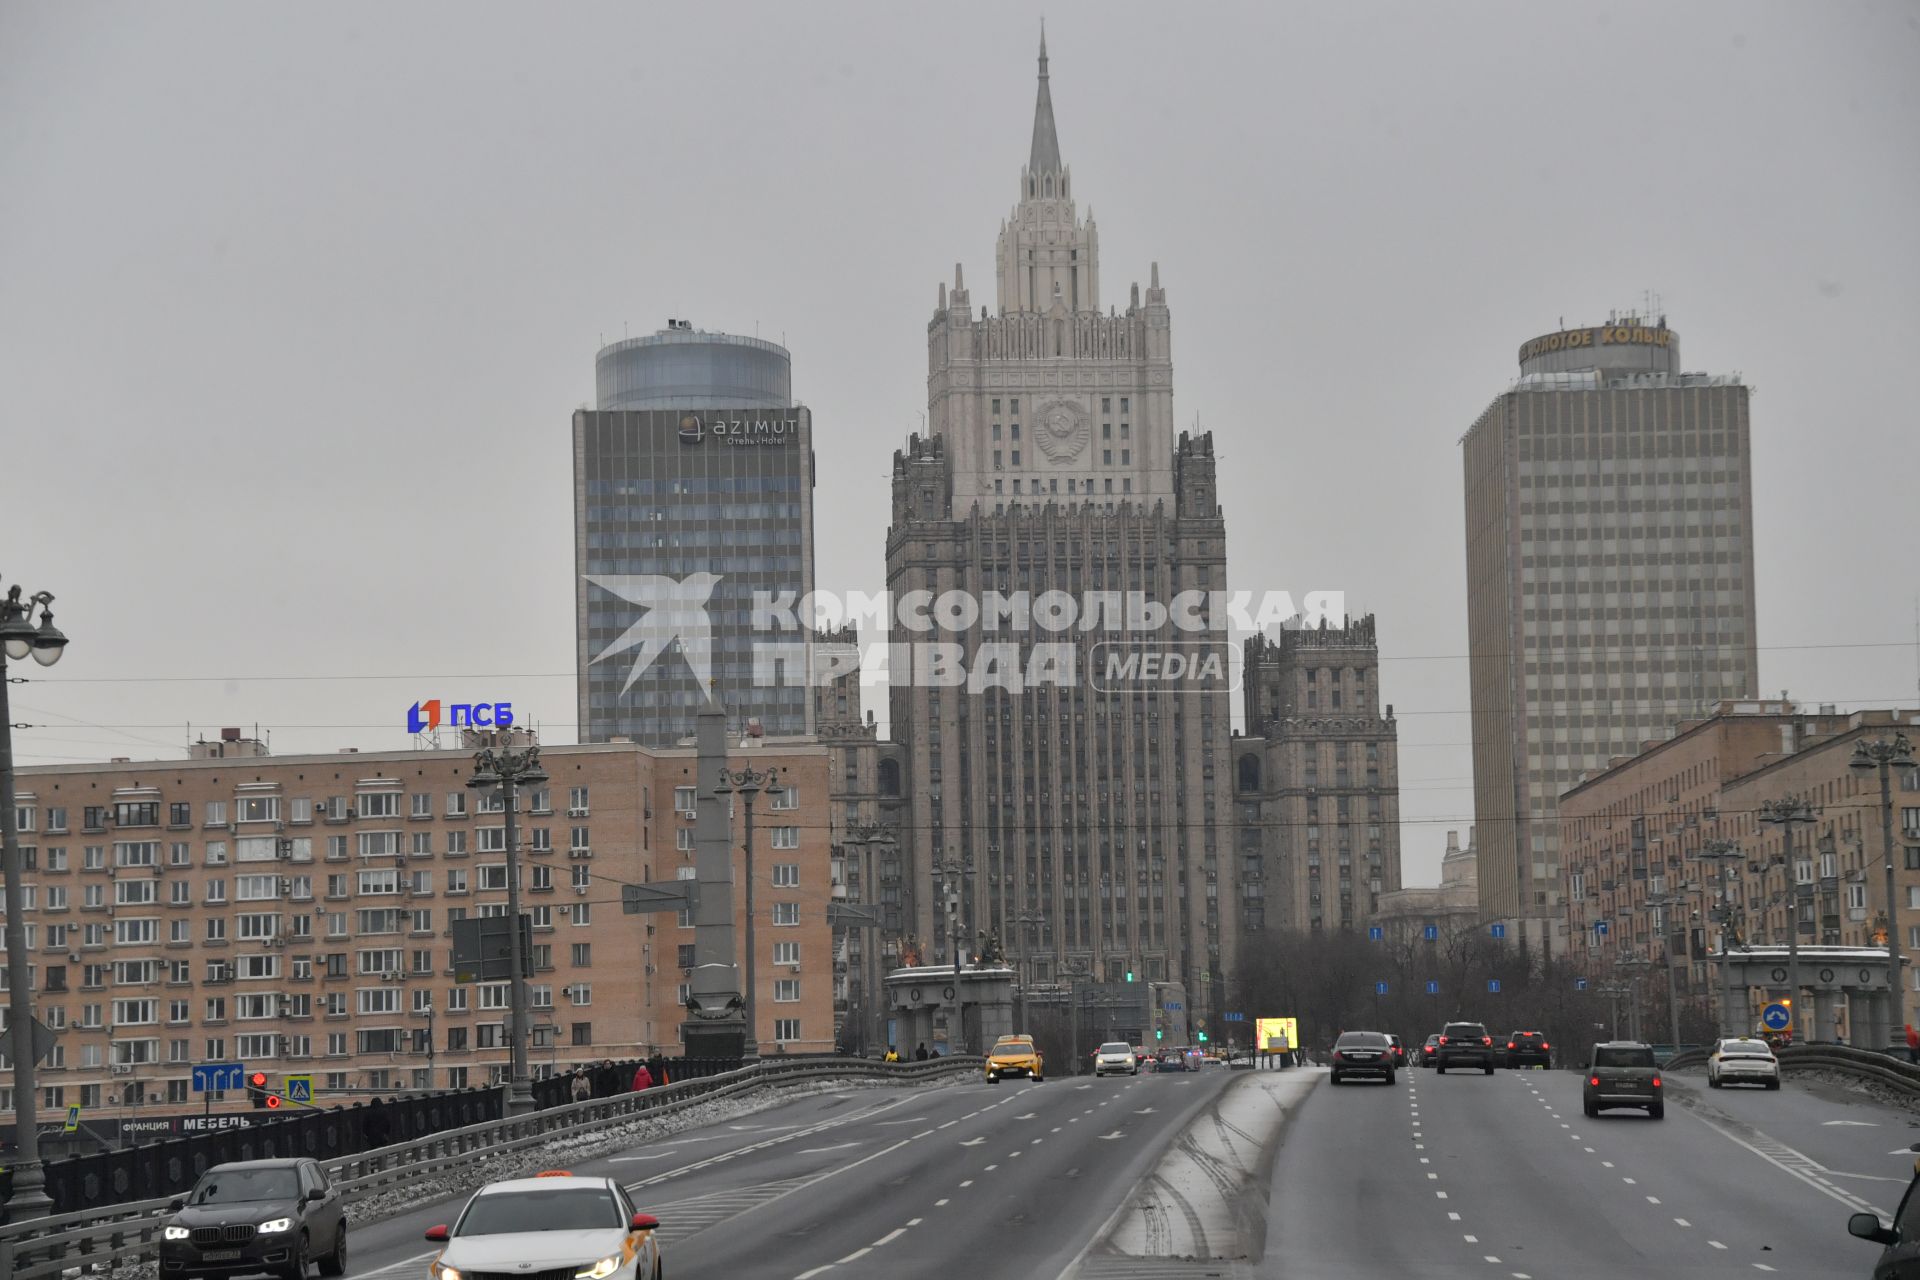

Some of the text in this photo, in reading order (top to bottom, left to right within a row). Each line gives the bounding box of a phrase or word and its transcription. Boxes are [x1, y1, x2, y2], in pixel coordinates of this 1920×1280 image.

[1602, 327, 1671, 347] КОЛЬЦО
[450, 702, 514, 727] ПСБ
[122, 1116, 250, 1132] ФРАНЦИЯ МЕБЕЛЬ
